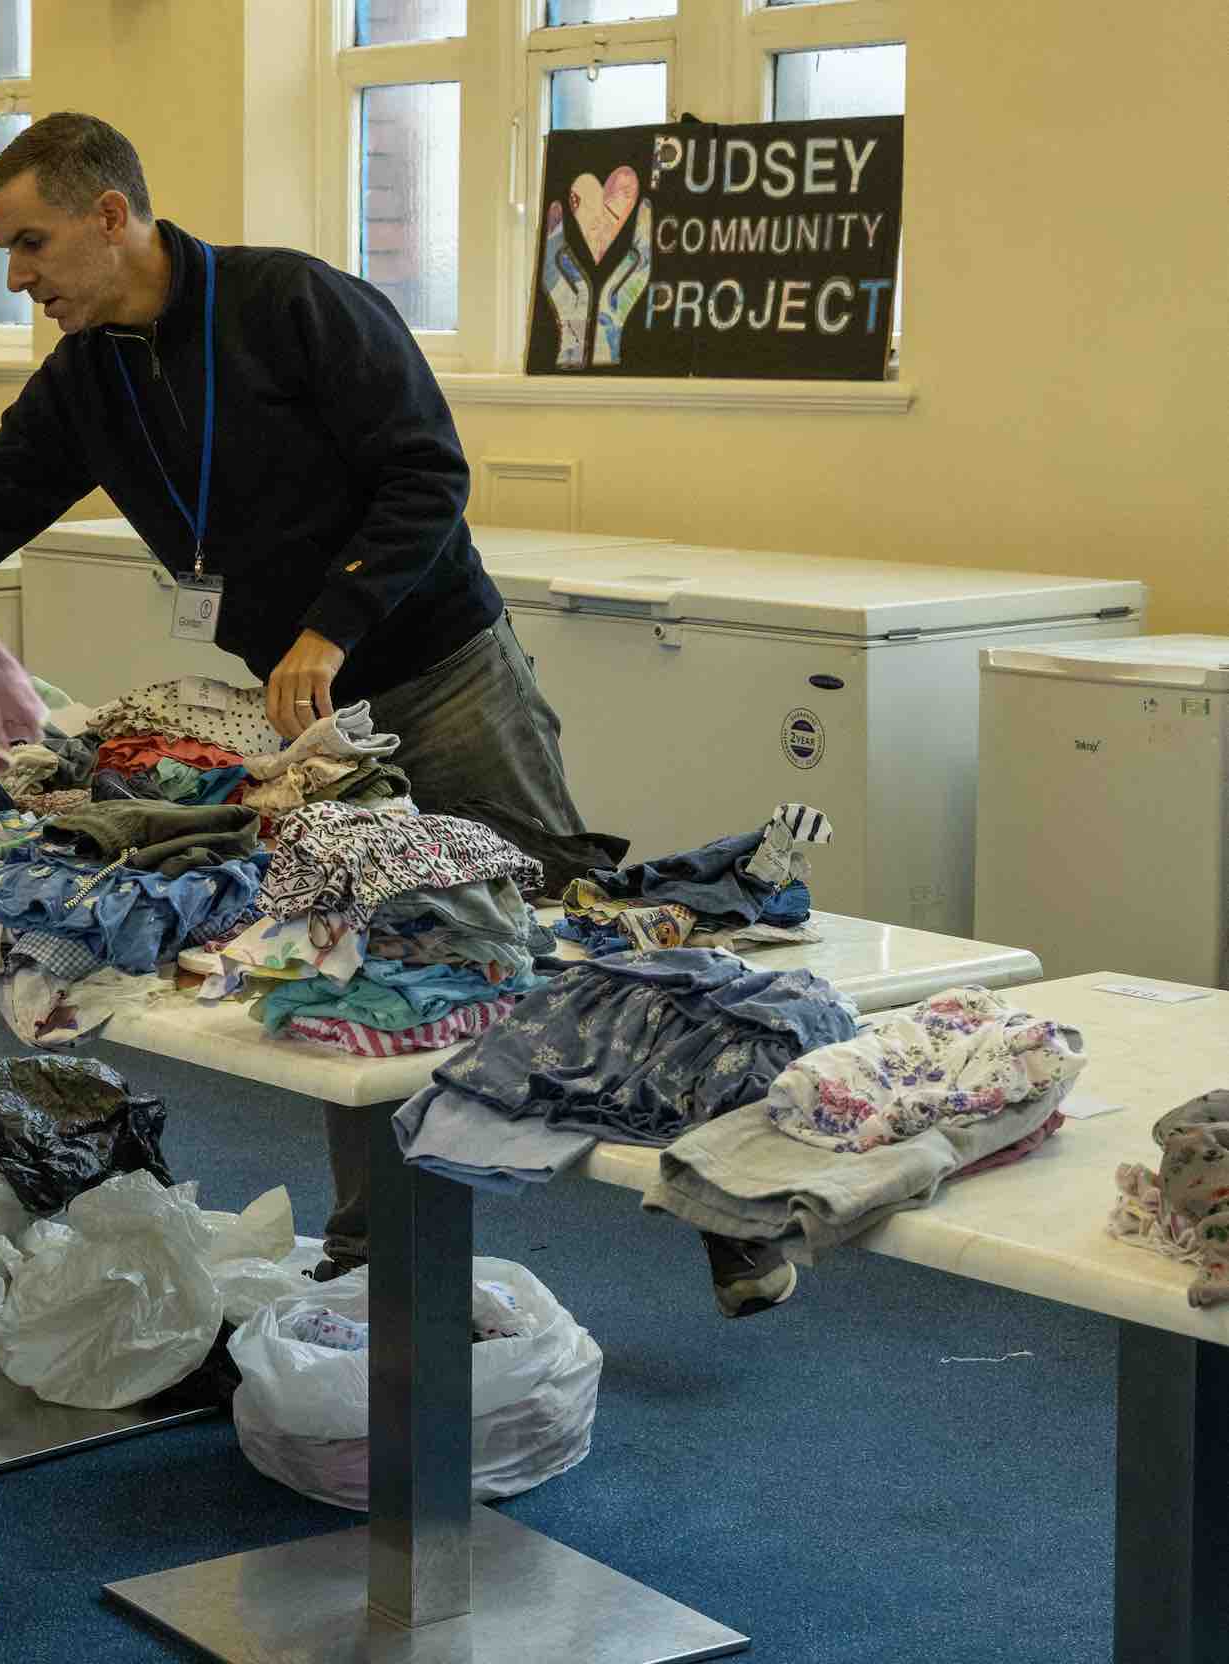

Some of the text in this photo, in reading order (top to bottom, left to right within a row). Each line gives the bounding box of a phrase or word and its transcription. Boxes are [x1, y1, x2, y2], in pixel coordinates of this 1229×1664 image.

[651, 135, 878, 197] PUDSEY
[656, 213, 883, 254] COMMUNITY
[645, 279, 892, 334] PROJECT
